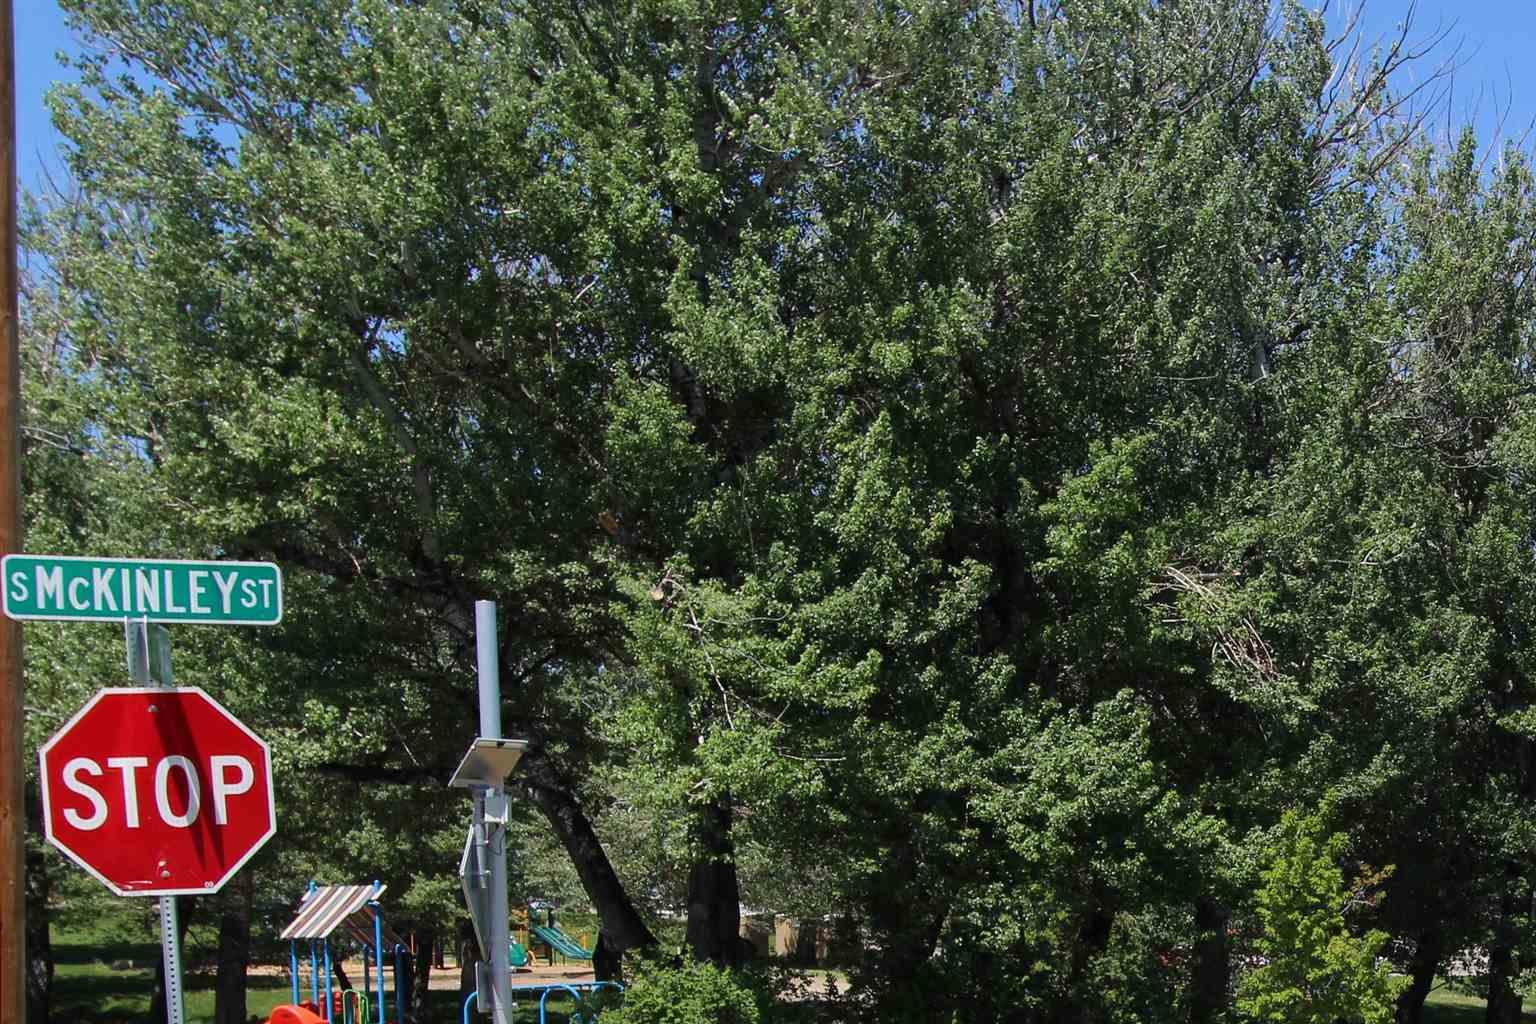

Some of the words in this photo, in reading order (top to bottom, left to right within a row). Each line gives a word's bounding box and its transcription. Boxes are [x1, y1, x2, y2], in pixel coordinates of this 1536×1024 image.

[11, 571, 29, 602] S
[240, 579, 274, 609] ST
[62, 755, 255, 830] STOP
